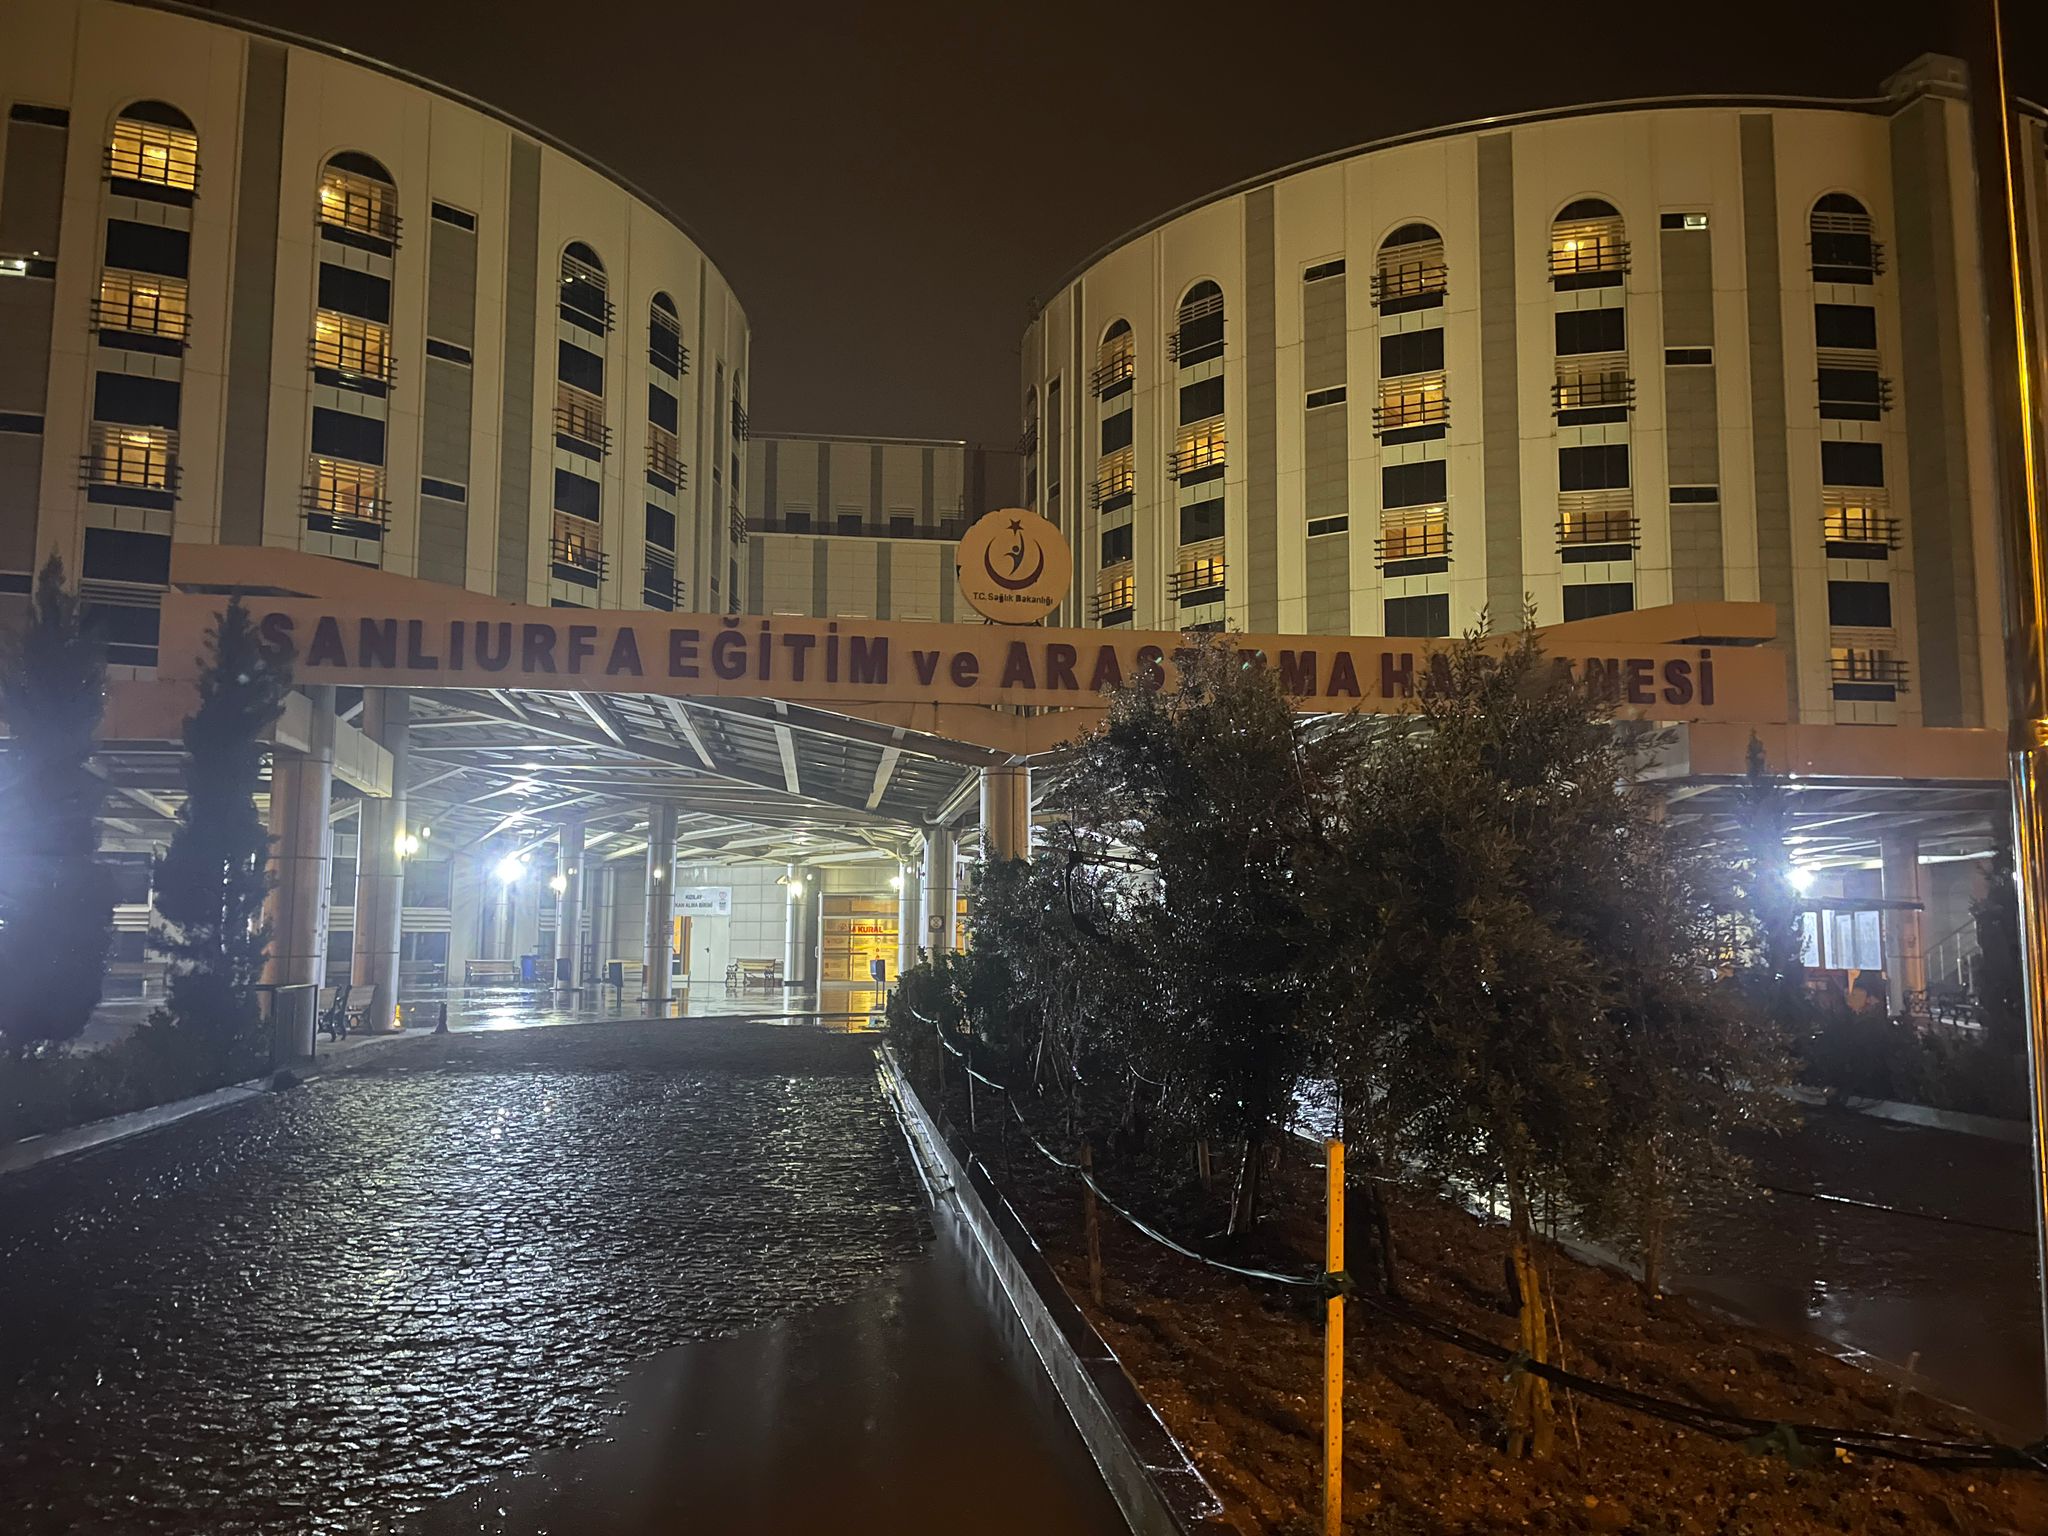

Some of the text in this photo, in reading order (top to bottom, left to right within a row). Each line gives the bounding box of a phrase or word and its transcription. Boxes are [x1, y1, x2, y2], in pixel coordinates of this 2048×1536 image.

[987, 593, 1014, 603] Sağlık
[1015, 594, 1054, 606] Bakanlığı
[668, 616, 888, 685] EĞİTİM
[912, 650, 979, 688] ve
